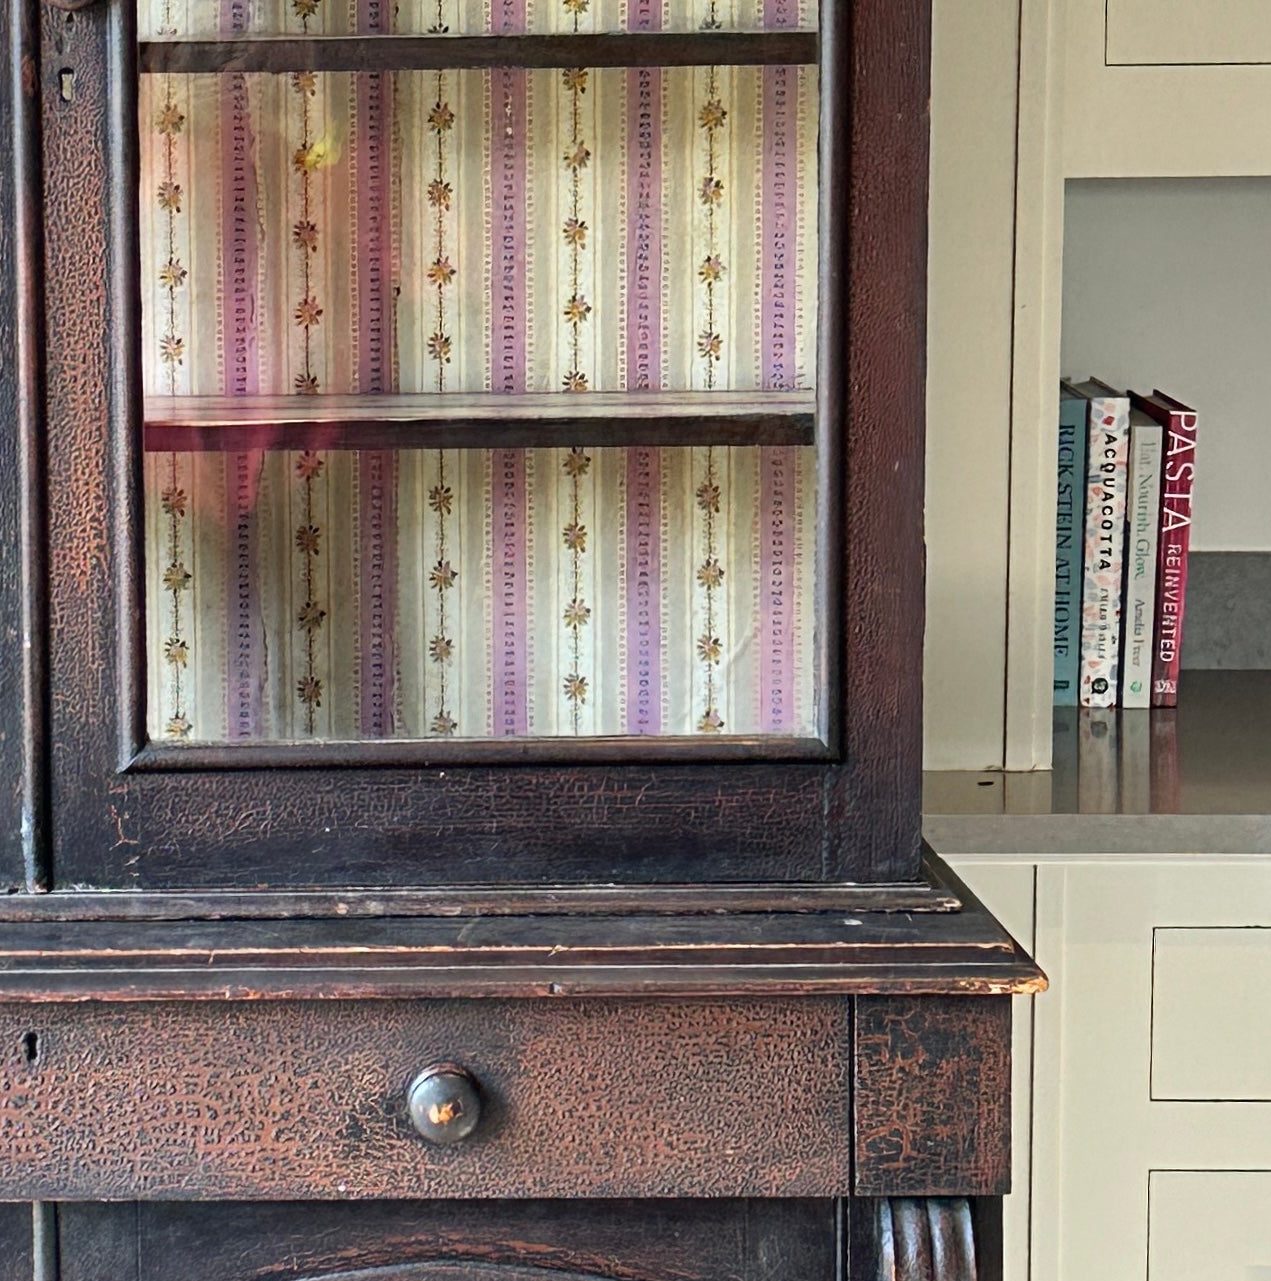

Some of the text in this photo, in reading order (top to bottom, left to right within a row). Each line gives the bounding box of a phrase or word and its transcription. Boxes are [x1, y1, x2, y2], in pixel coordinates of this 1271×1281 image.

[1056, 483, 1073, 549] STEIN
[1099, 433, 1118, 570] ACQUACOTTA
[1162, 410, 1198, 533] PASTA
[1054, 591, 1070, 657] HOME
[1159, 544, 1182, 662] REINVENTED
